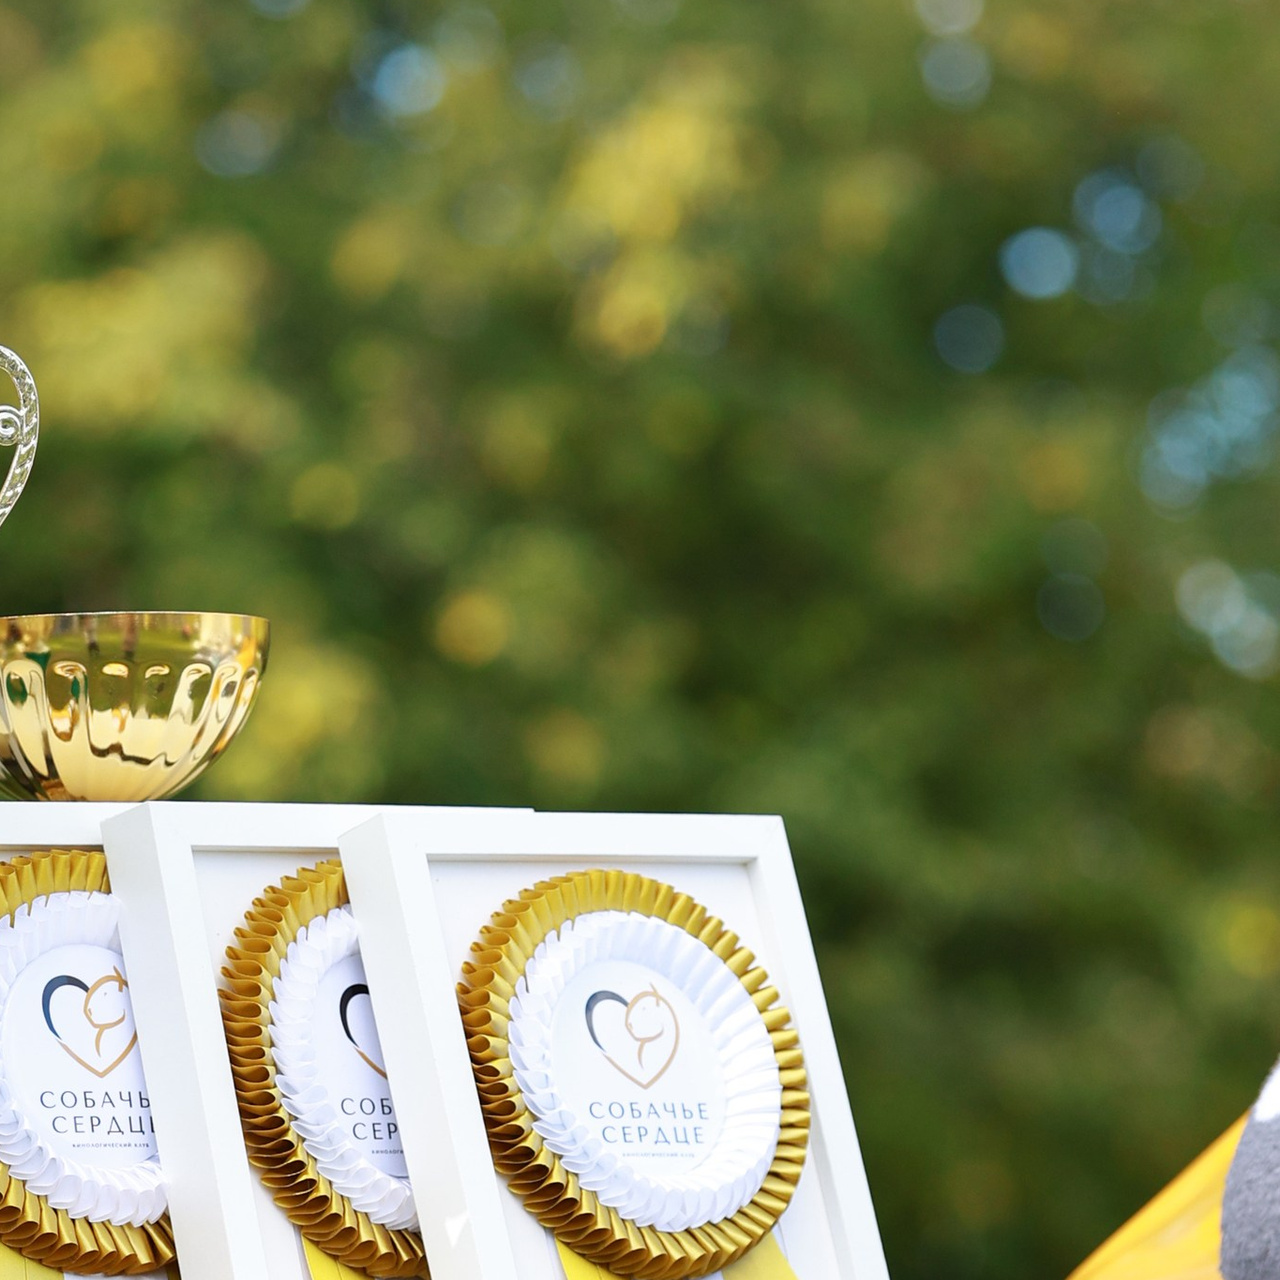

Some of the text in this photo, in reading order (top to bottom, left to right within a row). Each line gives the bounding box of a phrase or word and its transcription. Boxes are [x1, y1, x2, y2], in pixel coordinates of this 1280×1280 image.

[40, 1090, 150, 1109] СОБАЧЬ
[589, 1101, 710, 1120] СОБАЧЬЕ
[602, 1125, 706, 1146] СЕРДЦЕ
